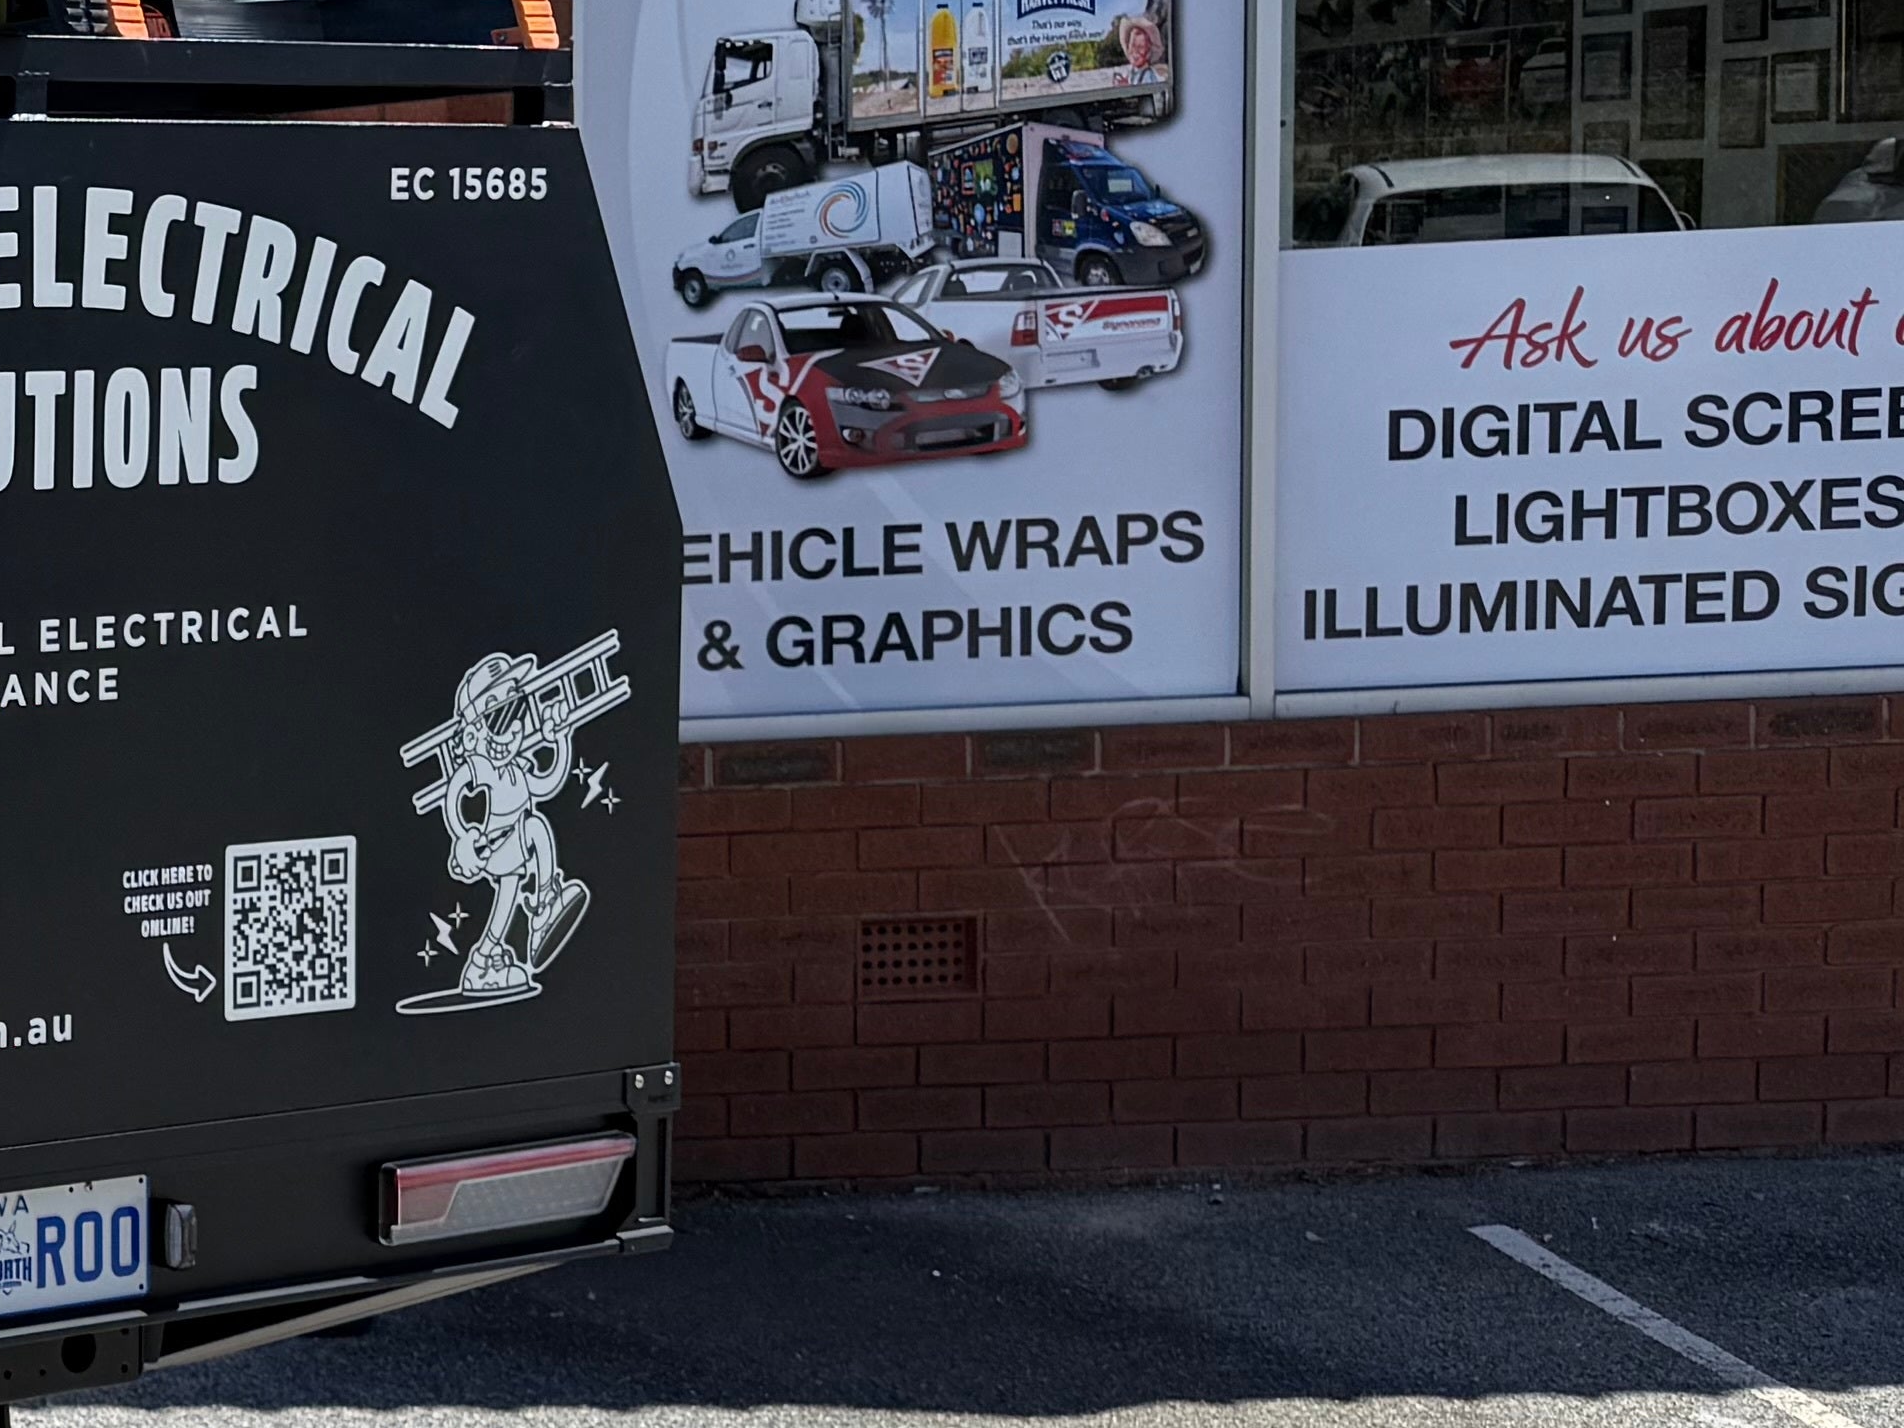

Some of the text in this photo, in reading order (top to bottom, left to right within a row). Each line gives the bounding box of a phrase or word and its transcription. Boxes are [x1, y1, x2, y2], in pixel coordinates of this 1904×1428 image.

[389, 167, 547, 203] EC 15685
[1449, 285, 1598, 370] Ask
[1618, 314, 1693, 361] us
[1715, 278, 1879, 357] about
[1388, 398, 1663, 461] DIGITAL
[945, 510, 1205, 572] WRAPS
[1454, 473, 1904, 547] LIGHTBOXES
[38, 604, 309, 655] ELECTRICAL
[697, 601, 1133, 671] & GRAPHICS
[1304, 570, 1780, 641] ILLUMINATED
[122, 864, 213, 889] CLICK HERE TO
[123, 888, 212, 914] CHECK US OUT
[141, 916, 196, 939] ONLINE!
[36, 1205, 141, 1290] ROO
